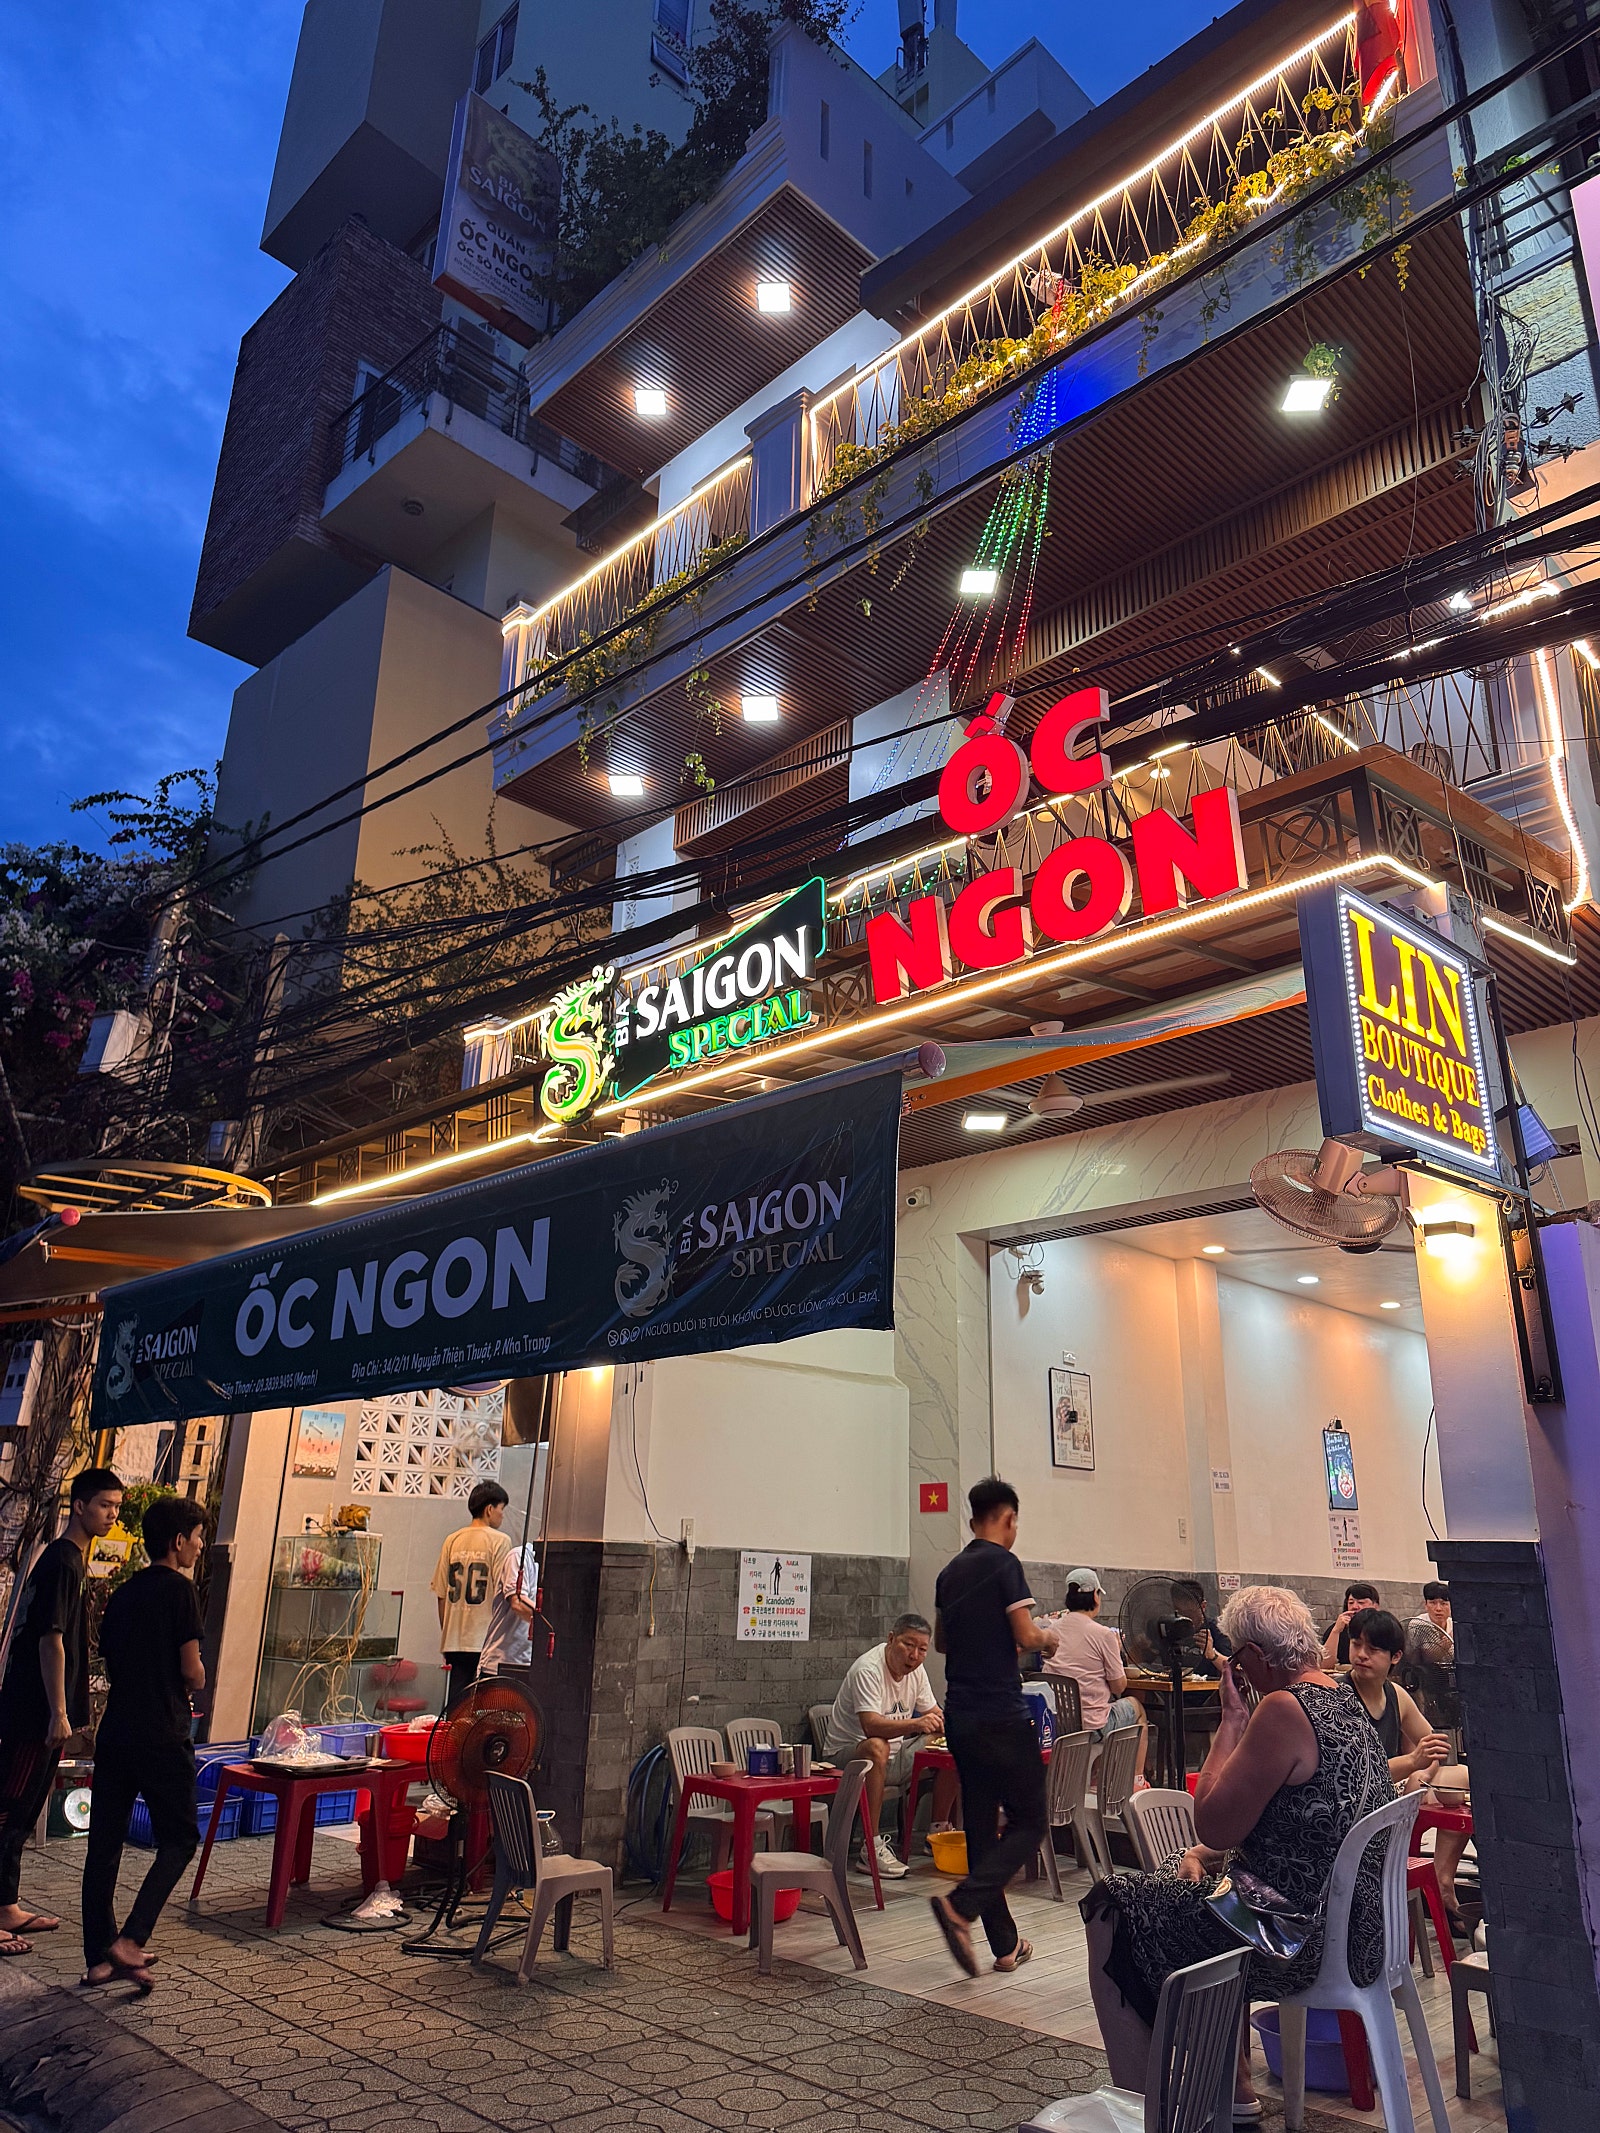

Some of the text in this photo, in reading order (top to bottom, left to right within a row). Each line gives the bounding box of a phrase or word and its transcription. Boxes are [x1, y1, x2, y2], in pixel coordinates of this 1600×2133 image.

[470, 166, 546, 234] SAIGON
[499, 175, 521, 200] BIA
[459, 217, 488, 251] ỐC
[486, 221, 526, 255] QUÁN
[495, 267, 518, 288] CÁC
[938, 686, 1112, 836] ỐC
[866, 786, 1250, 1006] NGON
[636, 925, 807, 1039] SAIGON
[1349, 909, 1467, 1057] LIN
[614, 998, 630, 1048] BIA
[669, 990, 812, 1068] SPECIAL
[1359, 1014, 1481, 1108] BOUTIQUE
[1368, 1074, 1487, 1156] Clothes & Bags
[679, 1210, 695, 1255] BIA
[698, 1176, 848, 1250] SAIGON
[730, 1231, 844, 1278] SPECIAL
[235, 1217, 552, 1357] ỐC NGON
[698, 1317, 707, 1331] 18
[732, 1307, 763, 1325] KHÔNG
[764, 1301, 796, 1319] ĐƯỢC
[144, 1324, 200, 1362] SAIGON
[351, 1363, 365, 1383] Địa
[382, 1356, 409, 1375] 34/2/11
[411, 1346, 442, 1373] Nguyễn
[442, 1346, 465, 1368] Thiện
[502, 1338, 521, 1355] Nha
[523, 1334, 551, 1354] Trang
[154, 1359, 195, 1380] SPECIAL
[294, 1369, 319, 1390] (Mạnh)
[448, 1561, 490, 1605] SG
